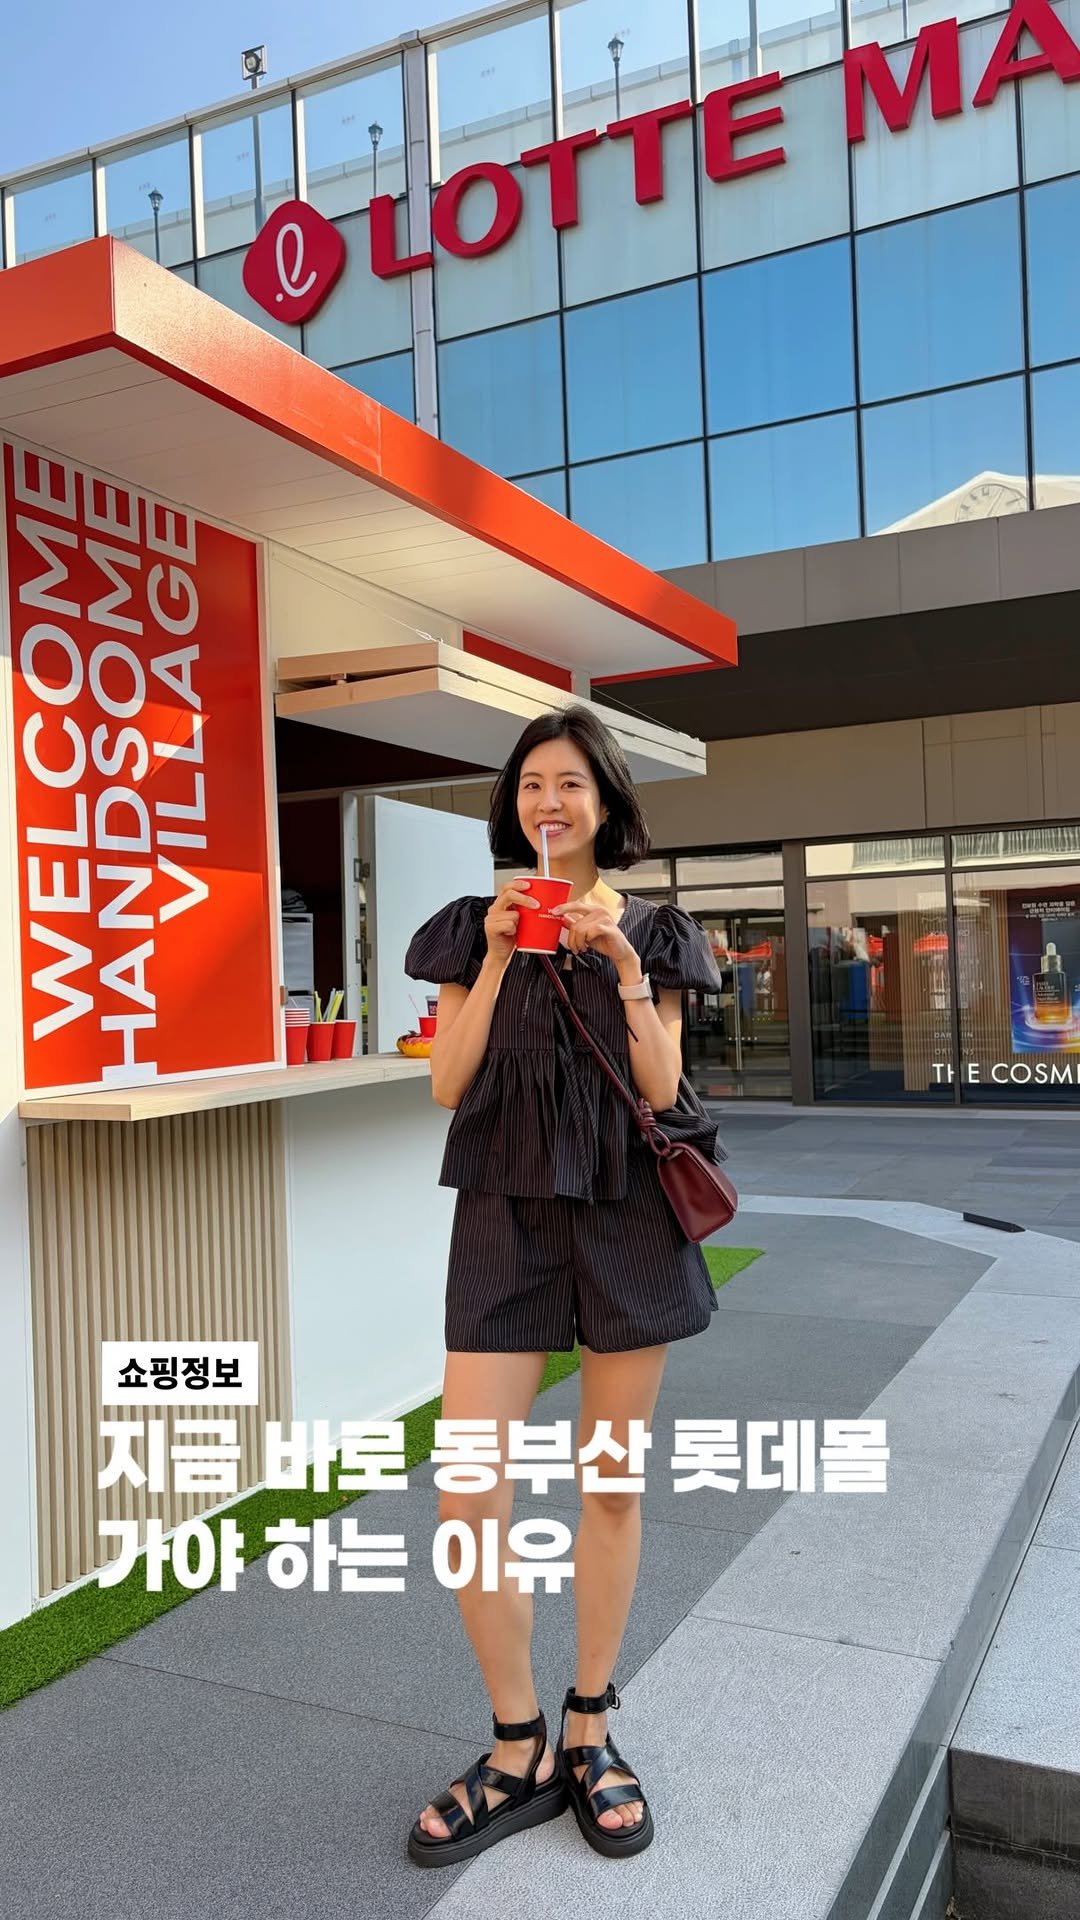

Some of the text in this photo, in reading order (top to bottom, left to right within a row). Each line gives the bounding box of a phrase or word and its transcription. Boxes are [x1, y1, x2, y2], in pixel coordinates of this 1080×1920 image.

[369, 71, 786, 279] LOTTE
[13, 438, 94, 1042] WELCOME
[82, 470, 158, 1084] HANDSOME
[145, 496, 210, 925] VILLAGE
